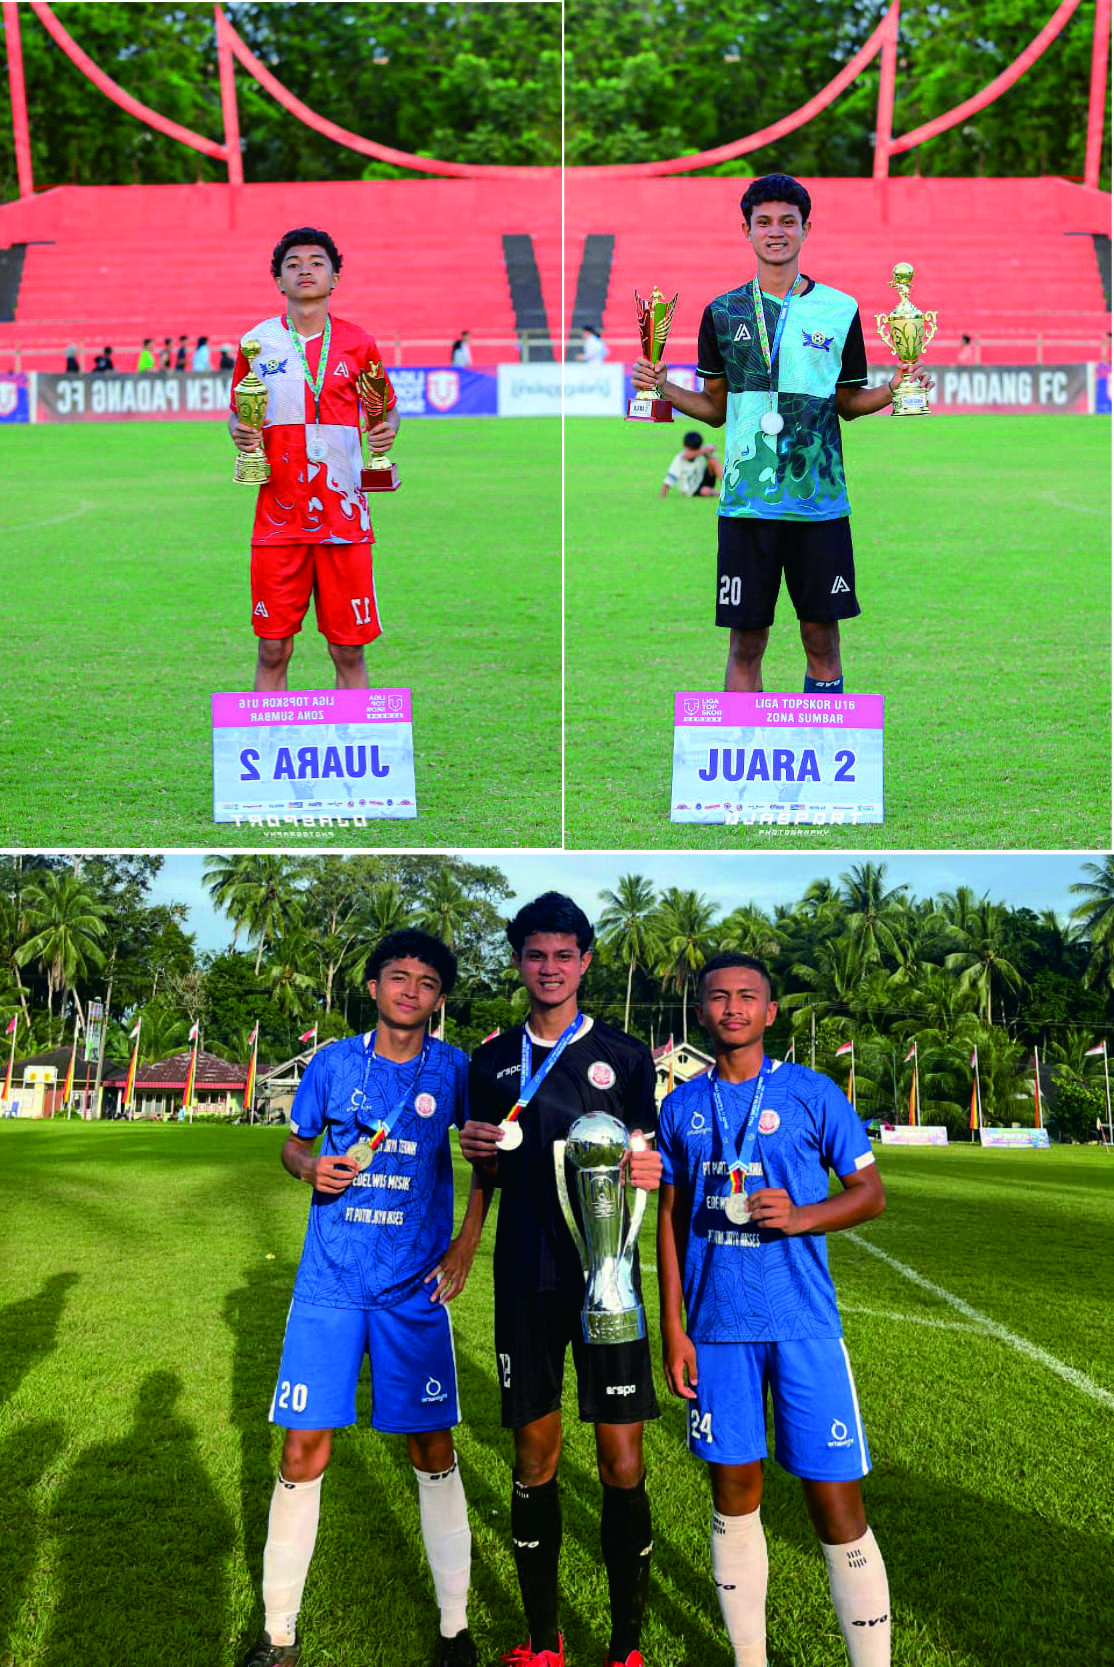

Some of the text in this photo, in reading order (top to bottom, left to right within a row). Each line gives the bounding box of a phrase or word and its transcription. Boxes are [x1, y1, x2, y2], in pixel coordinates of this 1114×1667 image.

[943, 371, 1033, 405] PADANG
[1038, 371, 1069, 406] FC
[719, 574, 742, 606] 20
[755, 698, 856, 710] LIGA TOPSKOR U16
[766, 712, 844, 724] ZONA SUMBAR
[698, 748, 856, 782] JUARA 2
[278, 1381, 308, 1413] 20
[691, 1409, 713, 1444] 24
